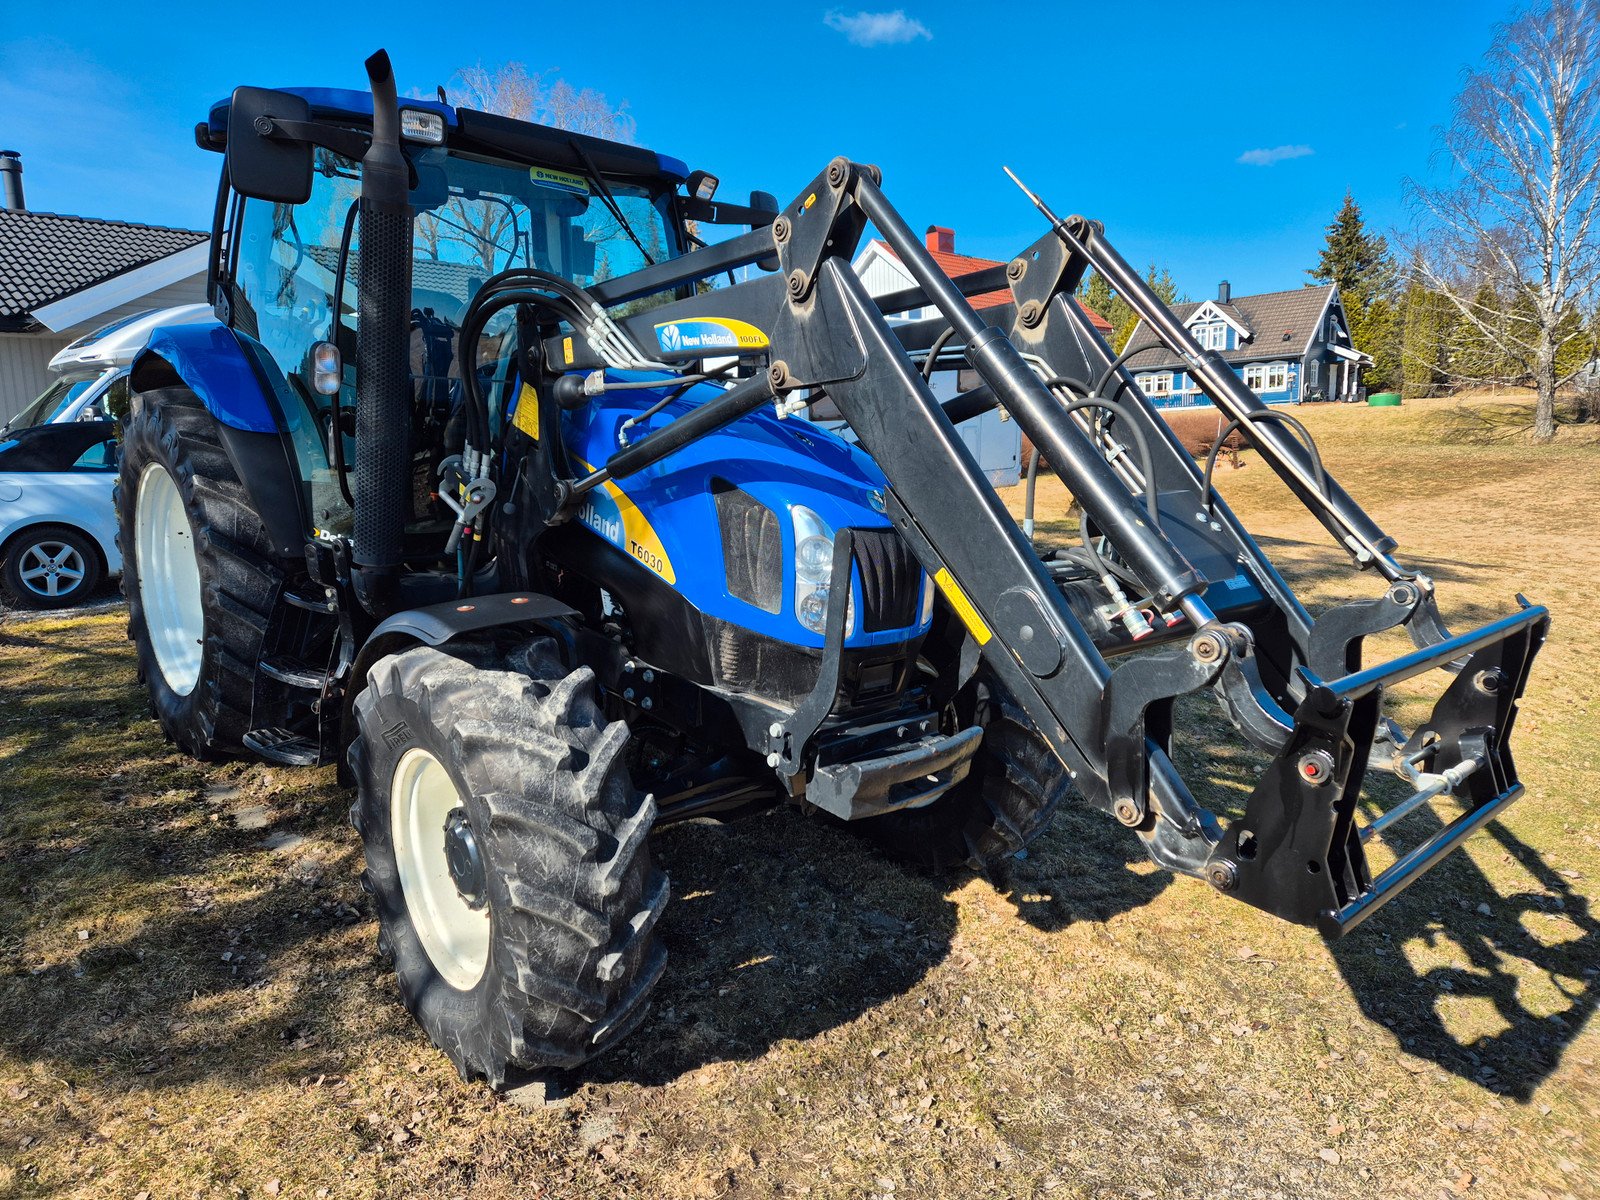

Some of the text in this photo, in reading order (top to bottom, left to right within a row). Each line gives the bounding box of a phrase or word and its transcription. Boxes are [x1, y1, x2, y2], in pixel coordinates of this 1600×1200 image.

[544, 173, 584, 186] NEW HOLLAND
[682, 333, 764, 346] New Holland 100FL
[576, 502, 620, 543] olland
[631, 540, 663, 573] T6030
